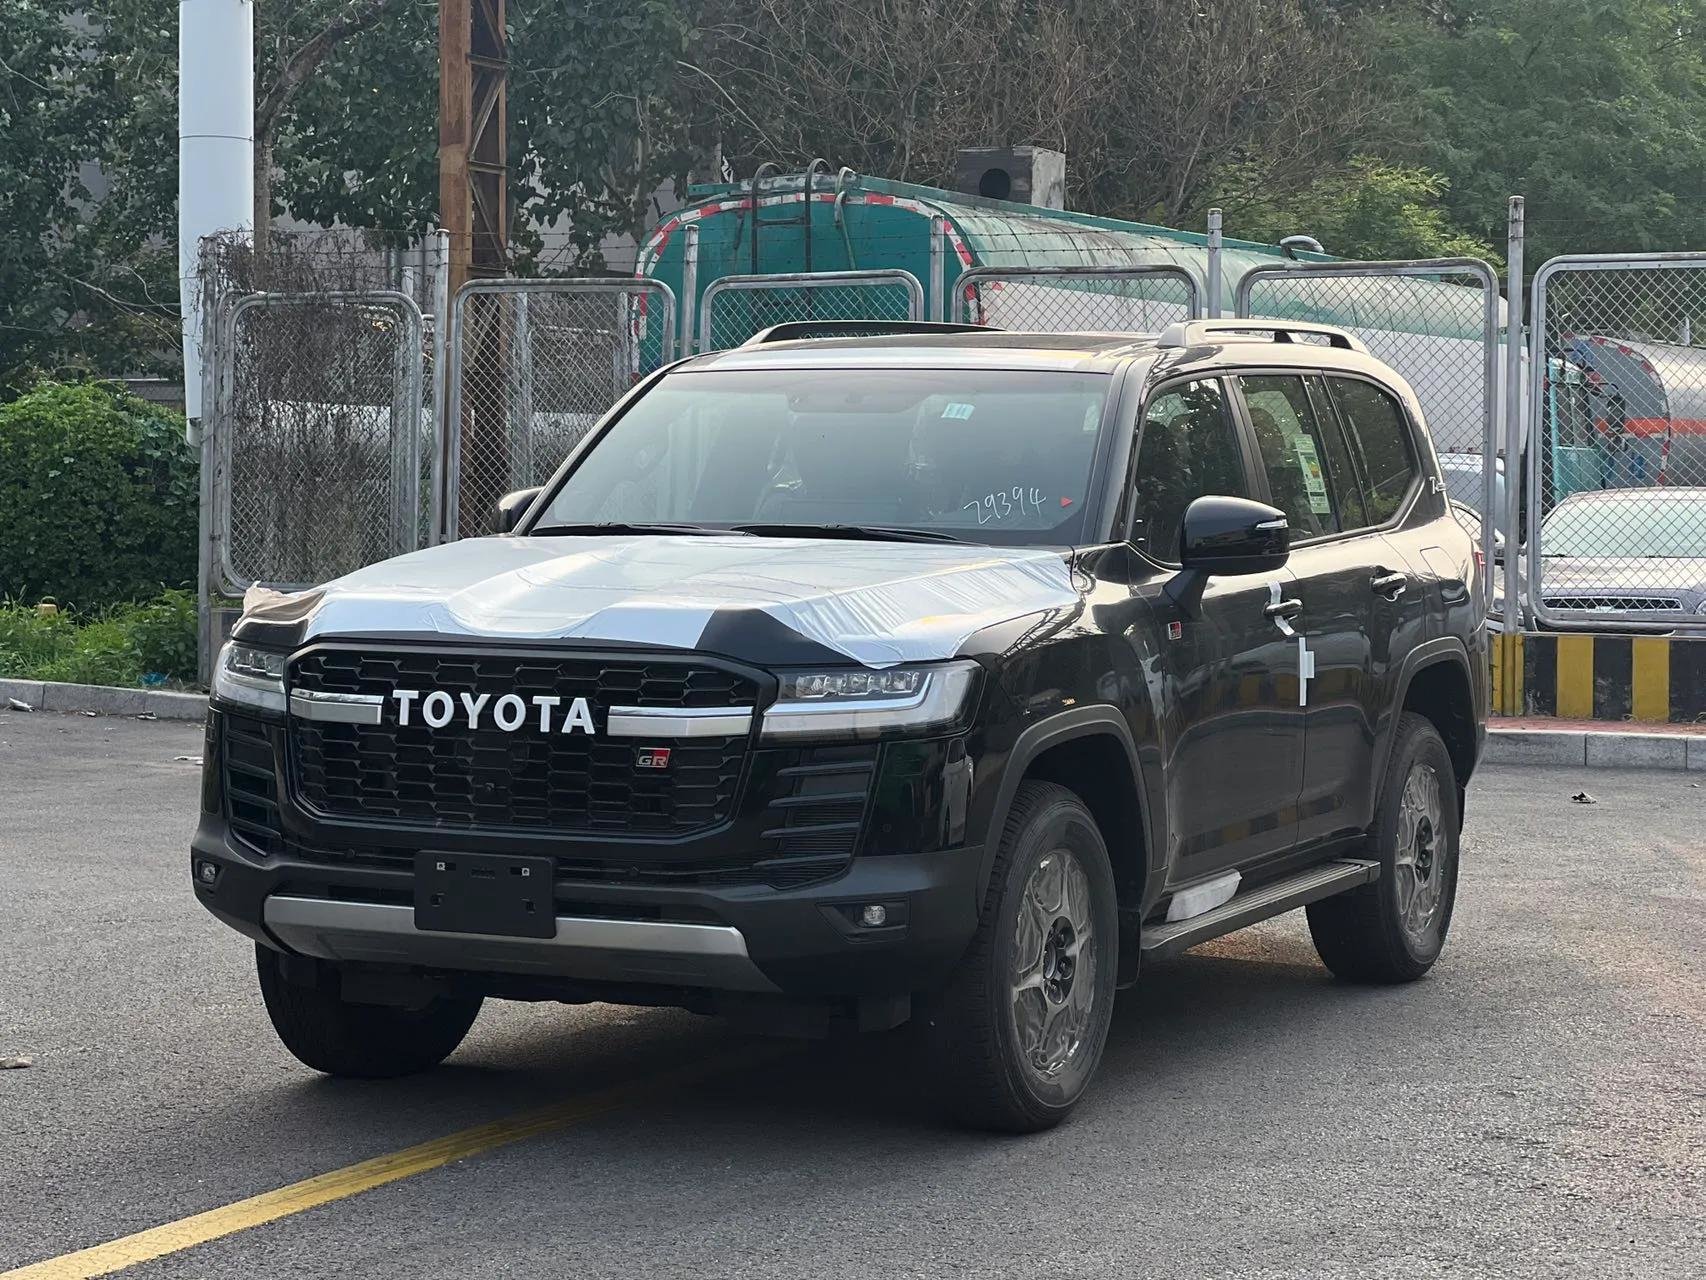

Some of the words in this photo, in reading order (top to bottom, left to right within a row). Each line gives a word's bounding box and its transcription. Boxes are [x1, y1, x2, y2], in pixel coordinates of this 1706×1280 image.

[963, 486, 1047, 525] 29394
[393, 689, 595, 734] TOYOTA
[638, 755, 667, 766] GR
